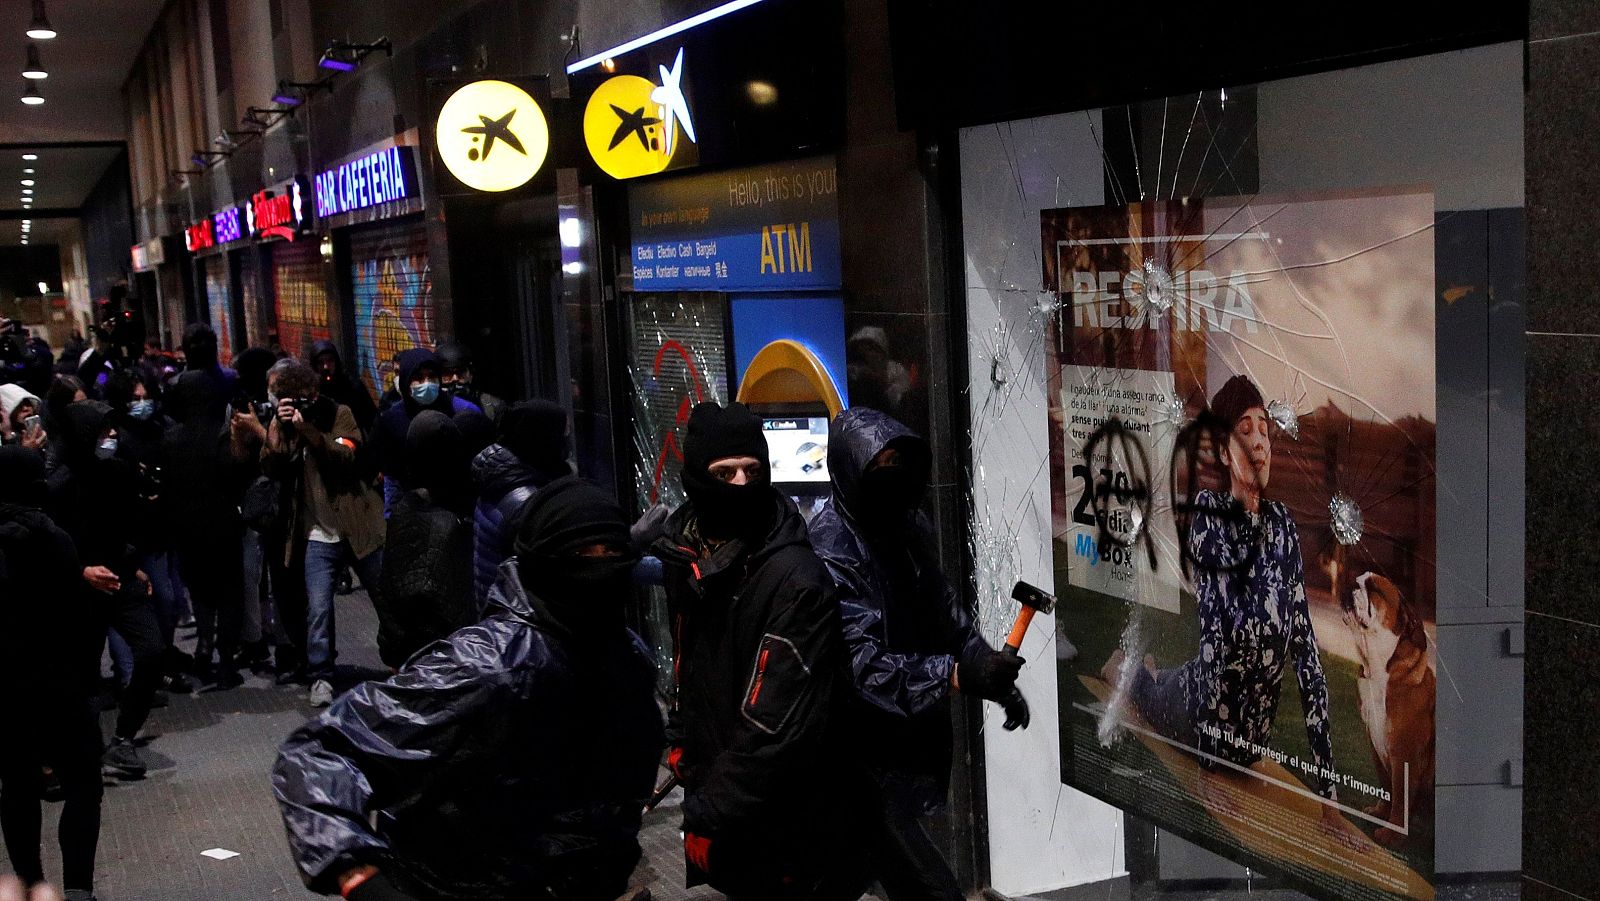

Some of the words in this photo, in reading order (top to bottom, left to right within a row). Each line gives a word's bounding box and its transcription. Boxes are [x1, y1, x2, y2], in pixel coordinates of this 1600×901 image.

[316, 170, 337, 217] BAR
[339, 146, 405, 212] CAFETERIA
[729, 173, 762, 208] Hello,
[765, 169, 789, 202] this
[793, 166, 804, 198] is
[679, 243, 693, 258] Cash
[696, 241, 717, 259] Bargeld
[761, 222, 812, 273] ATM
[656, 265, 680, 278] Kontanter
[1071, 400, 1080, 409] de
[1072, 415, 1091, 426] sense
[1123, 420, 1150, 432] durant
[1072, 428, 1086, 439] tres
[1202, 724, 1221, 739] AMB
[1223, 730, 1234, 744] TU
[1252, 743, 1288, 764] protegir
[1290, 755, 1299, 768] el
[1301, 761, 1318, 776] que
[1320, 768, 1340, 782] més
[1343, 774, 1391, 802] t'importa
